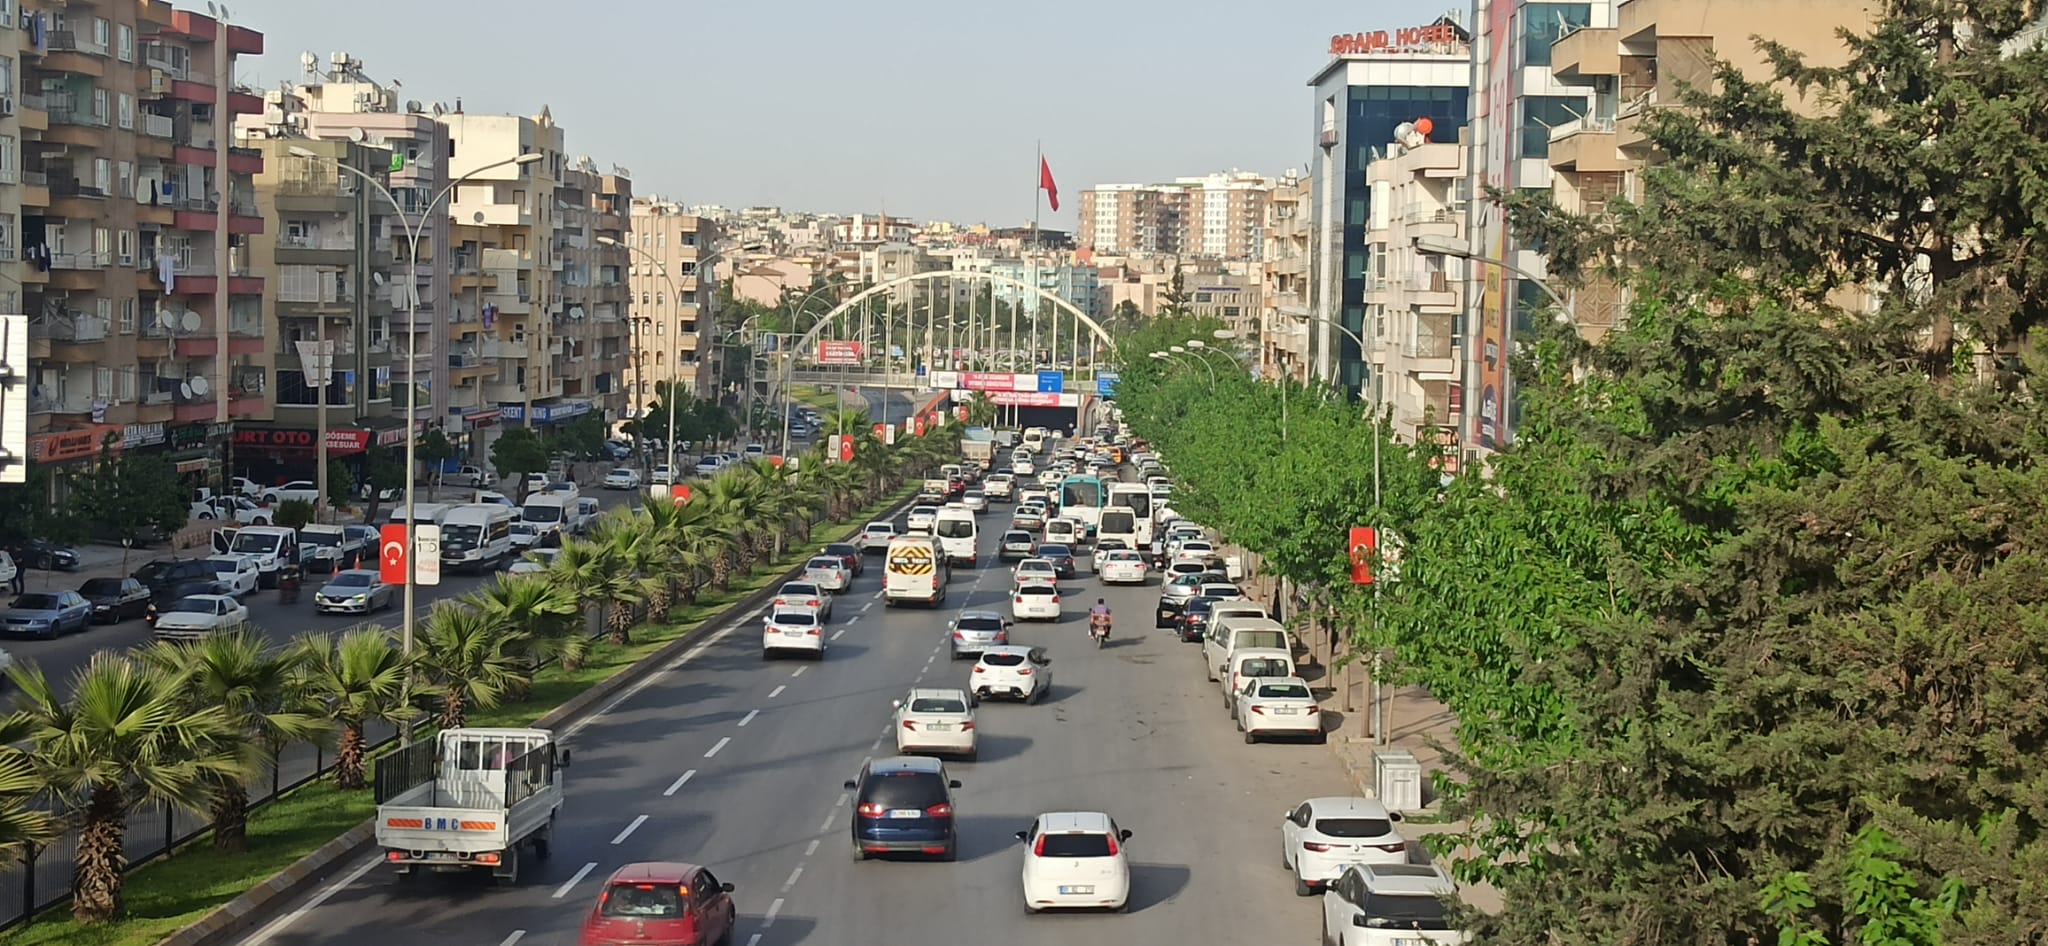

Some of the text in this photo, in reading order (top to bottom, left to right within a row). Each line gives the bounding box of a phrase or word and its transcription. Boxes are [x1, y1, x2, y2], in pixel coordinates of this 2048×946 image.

[1329, 24, 1454, 54] GRAND HOTEL
[232, 430, 311, 445] URT OTO
[325, 440, 360, 449] KSESUAR
[424, 817, 459, 831] BMC
